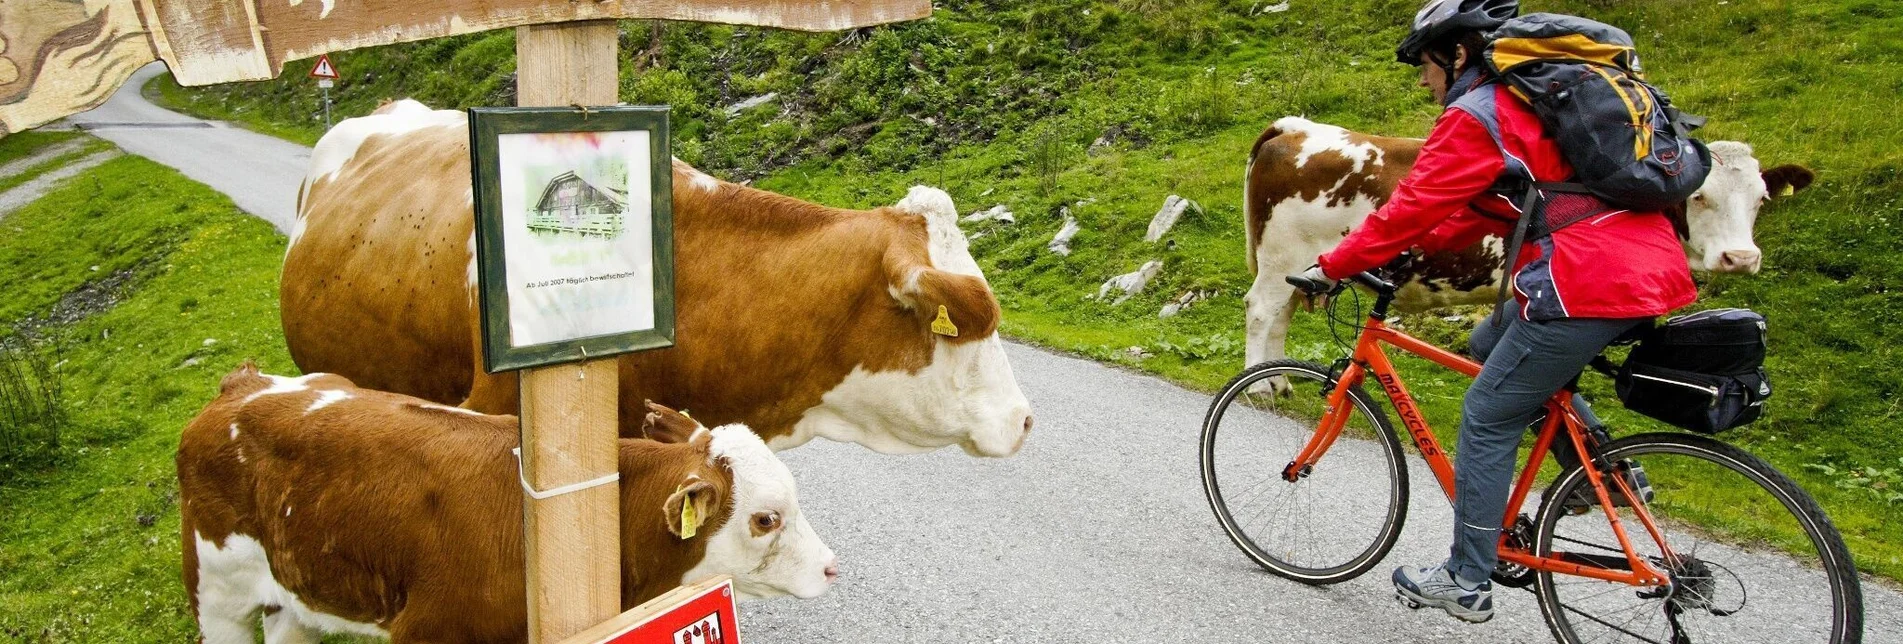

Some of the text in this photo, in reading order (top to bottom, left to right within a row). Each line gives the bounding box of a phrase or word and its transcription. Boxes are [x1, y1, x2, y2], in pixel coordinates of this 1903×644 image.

[537, 280, 549, 288] Juli
[550, 278, 565, 286] 2007
[566, 277, 589, 285] täglich
